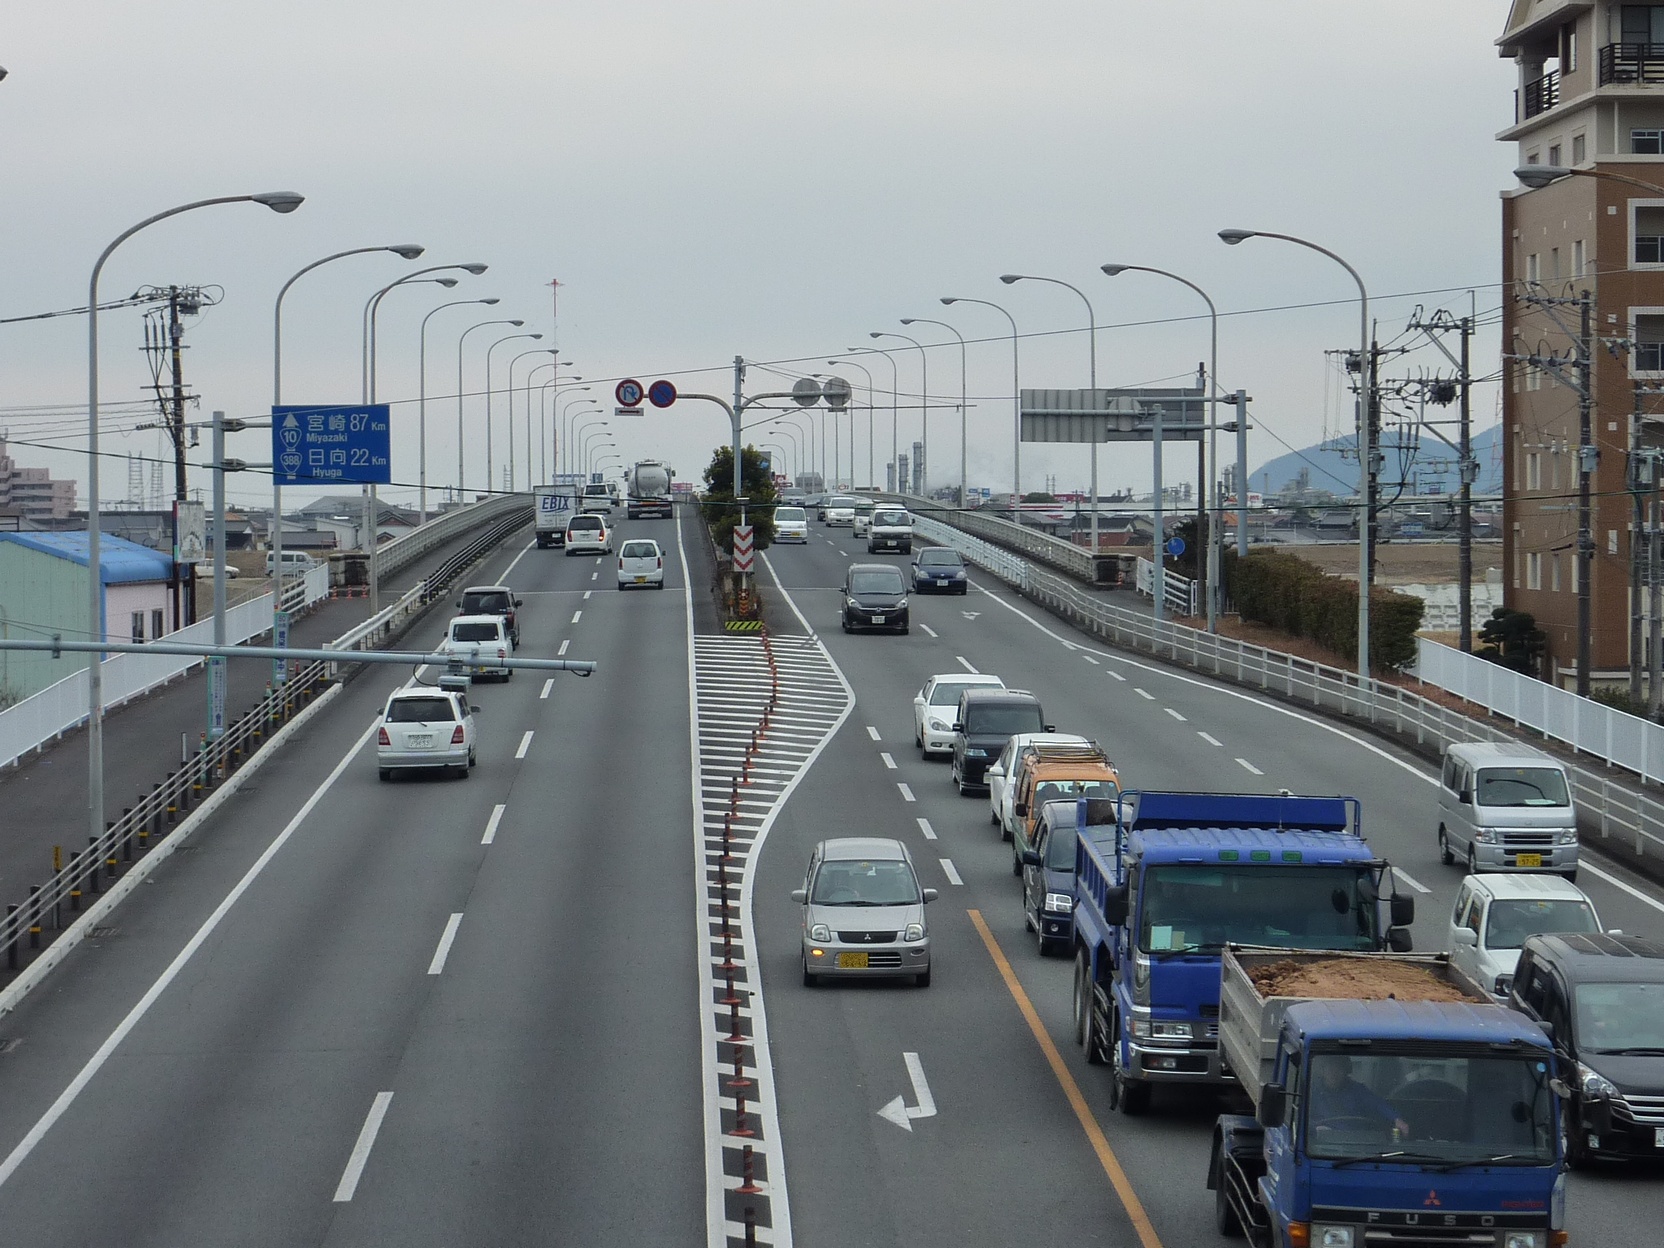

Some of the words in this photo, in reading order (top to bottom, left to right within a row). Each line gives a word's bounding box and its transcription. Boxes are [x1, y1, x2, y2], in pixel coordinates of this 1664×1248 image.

[307, 414, 346, 431] 宮崎
[350, 414, 368, 431] 87
[371, 422, 386, 431] Km
[283, 431, 297, 443] 10
[306, 433, 348, 443] Miyazaki
[283, 455, 300, 466] 388
[309, 448, 346, 465] 日向
[351, 448, 369, 466] 22
[372, 456, 387, 465] Km
[312, 467, 342, 478] Hyuga
[541, 496, 570, 510] EBIX
[1367, 1212, 1495, 1226] FUSO
